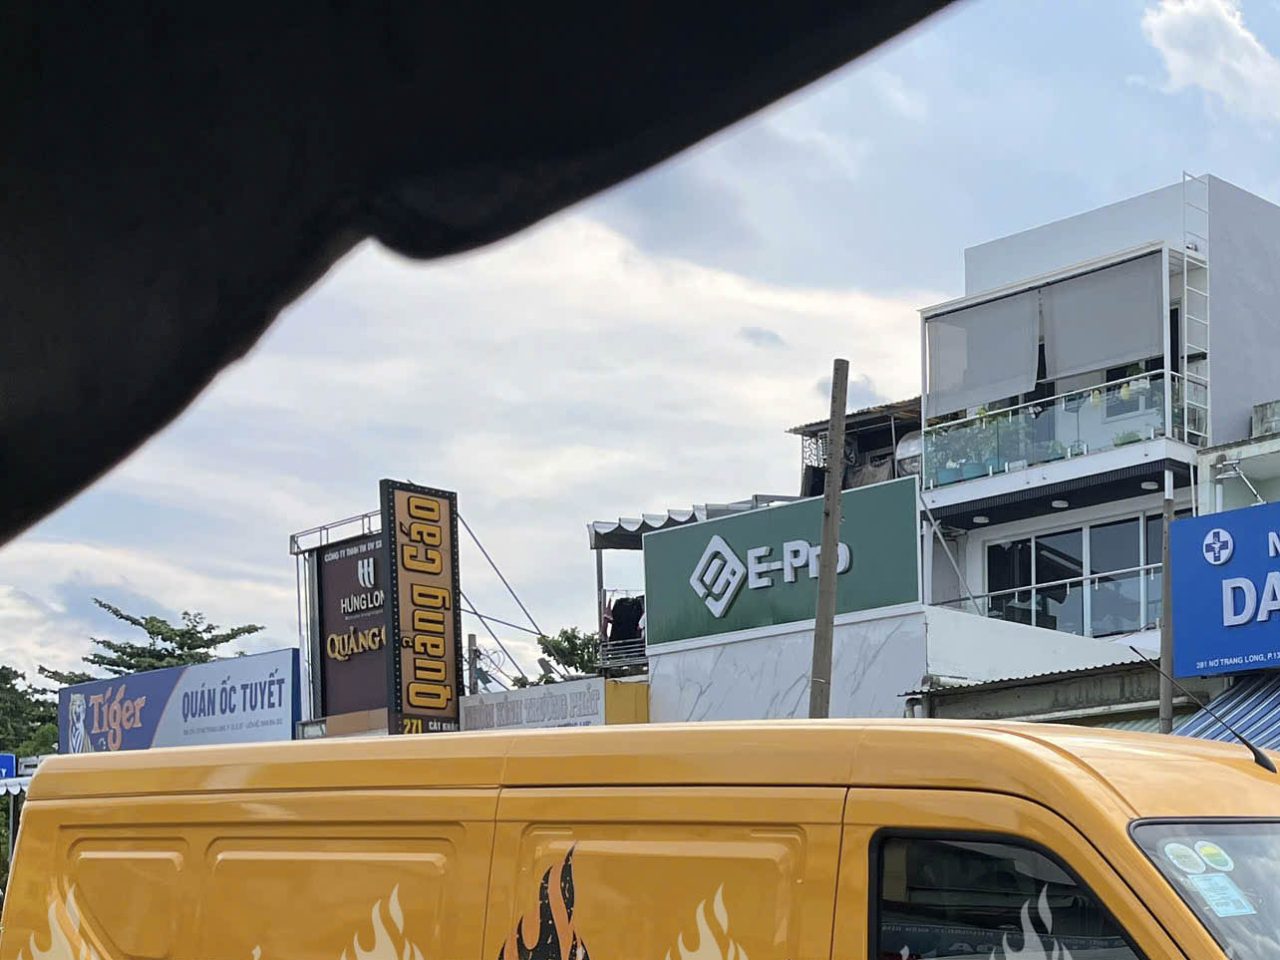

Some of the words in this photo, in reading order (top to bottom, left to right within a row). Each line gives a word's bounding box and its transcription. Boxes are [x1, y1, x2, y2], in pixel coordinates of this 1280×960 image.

[399, 495, 444, 576] Cáo
[1220, 656, 1243, 666] TRANG
[89, 684, 146, 752] Tiger
[182, 682, 216, 723] QUÁN
[220, 675, 237, 714] ỐC
[241, 667, 286, 712] TUYẾT
